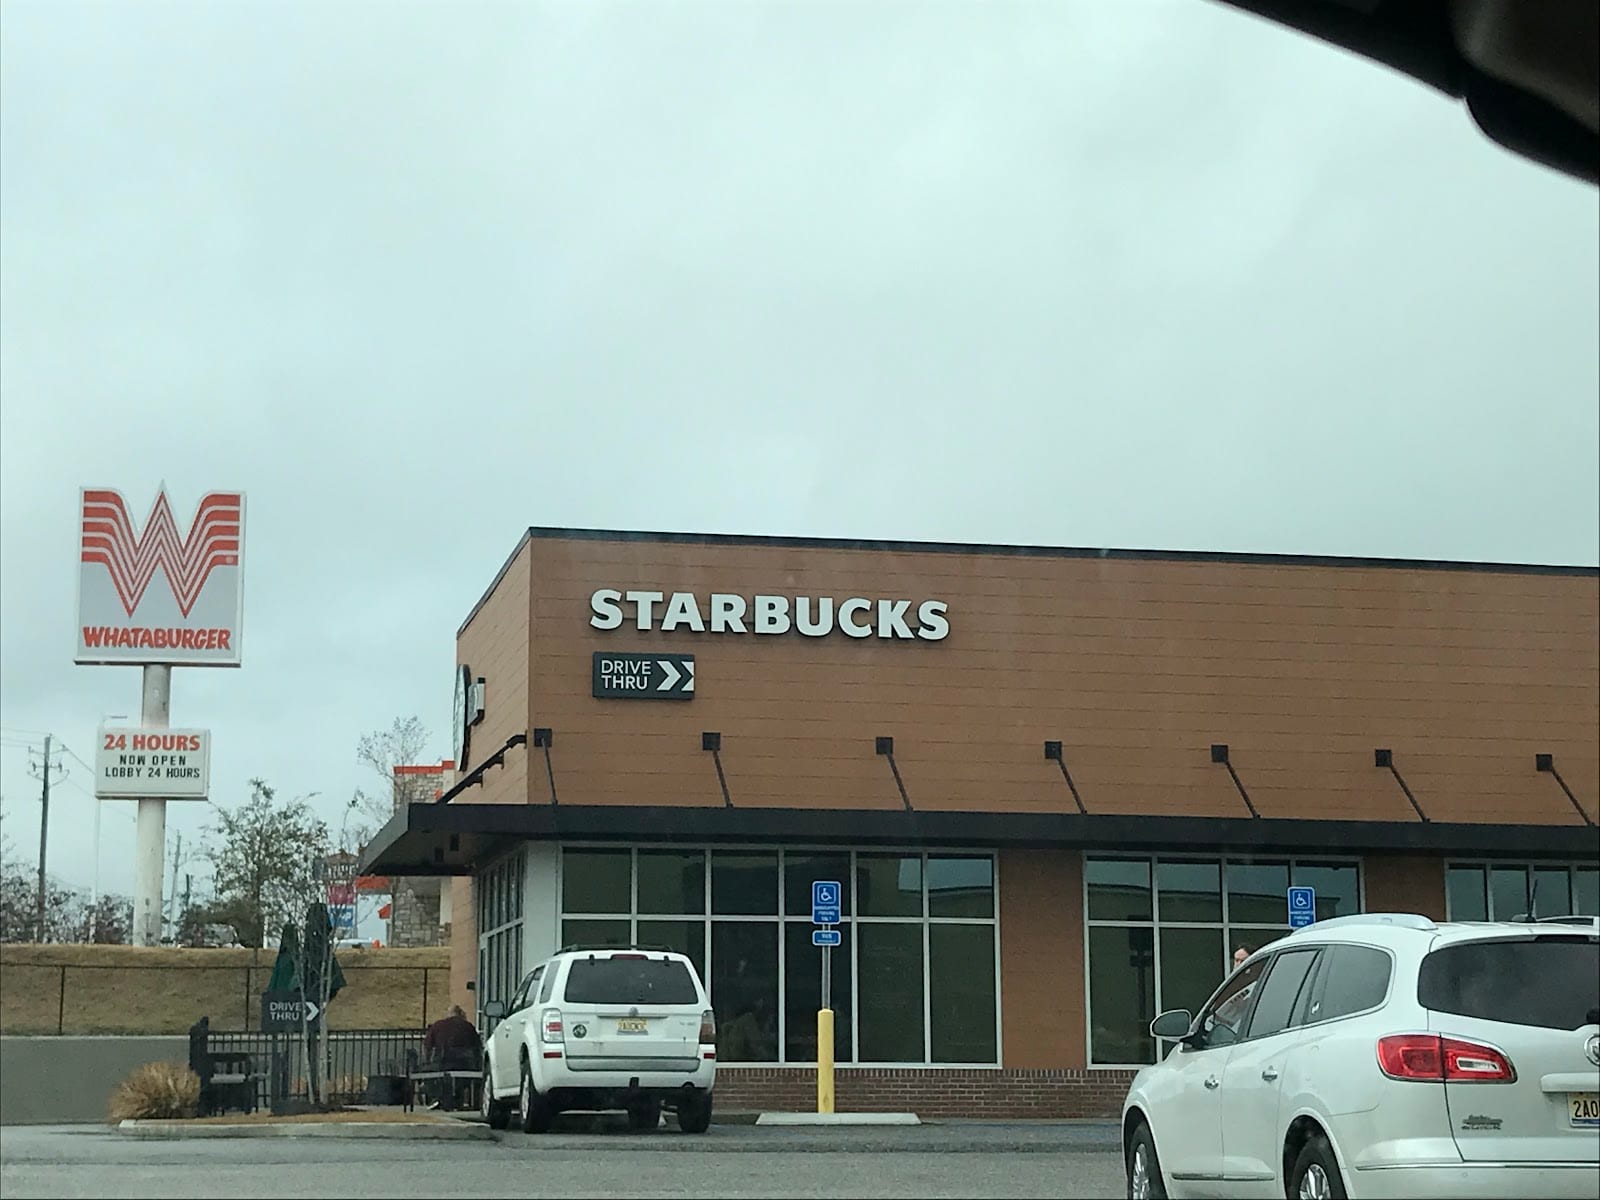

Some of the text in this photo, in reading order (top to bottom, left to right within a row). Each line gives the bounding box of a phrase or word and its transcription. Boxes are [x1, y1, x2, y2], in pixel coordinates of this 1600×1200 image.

[589, 588, 951, 641] STARBUCKS
[82, 626, 231, 650] WHATABURGER
[600, 659, 652, 675] DRIVE
[600, 674, 649, 690] THRU
[103, 733, 200, 751] 24 HOURS
[119, 754, 186, 766] NOW OPEN
[104, 766, 200, 778] LOBBY 24 HOURS
[270, 1001, 302, 1011] DRIVE
[270, 1011, 300, 1021] THRU
